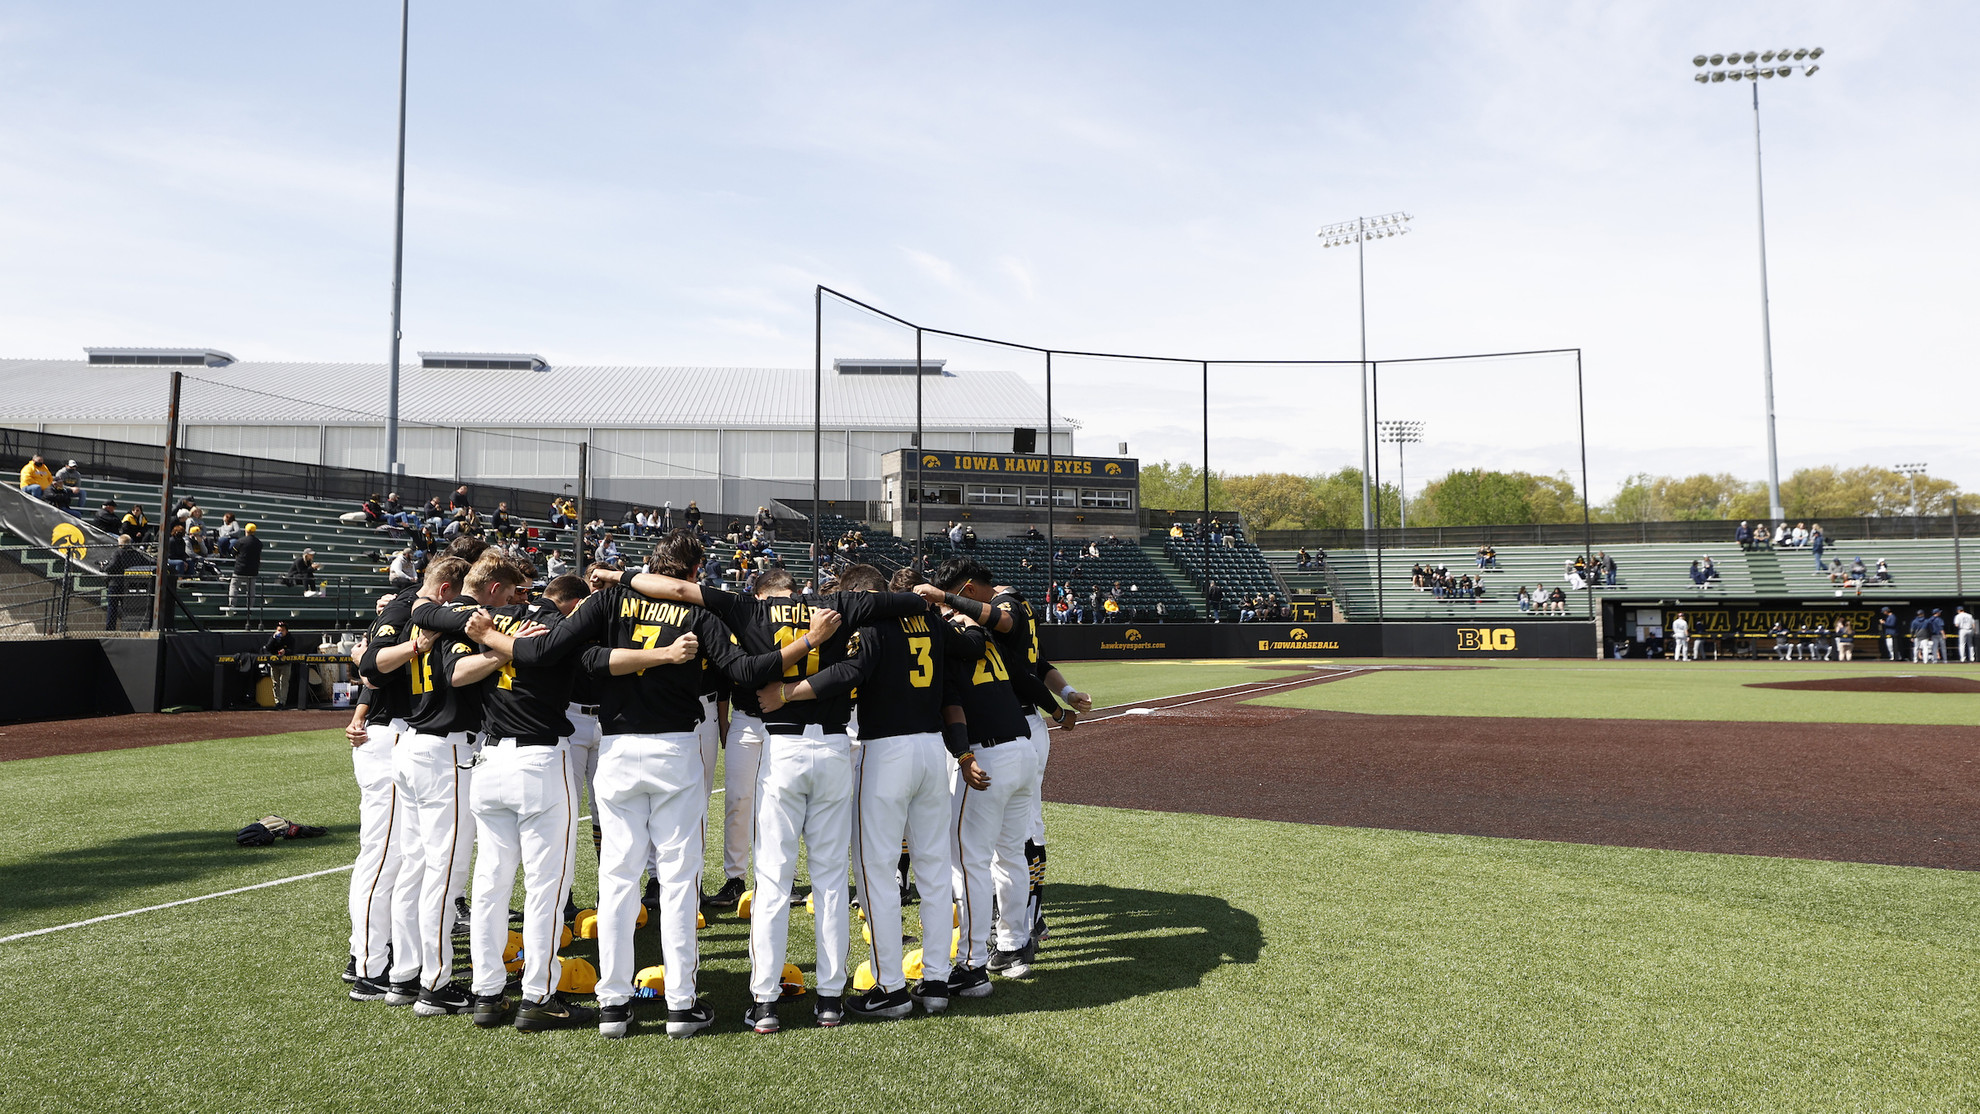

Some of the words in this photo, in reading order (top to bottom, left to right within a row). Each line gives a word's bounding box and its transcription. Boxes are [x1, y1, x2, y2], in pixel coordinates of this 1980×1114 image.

[955, 456, 999, 471] IOWA
[1005, 458, 1092, 474] HAWKEYES
[620, 597, 690, 628] ANTHONY
[900, 616, 930, 634] LINK
[631, 623, 662, 676] 7
[1100, 641, 1166, 651] hawkeyesports.com
[908, 636, 934, 688] 3
[971, 640, 1010, 686] 20
